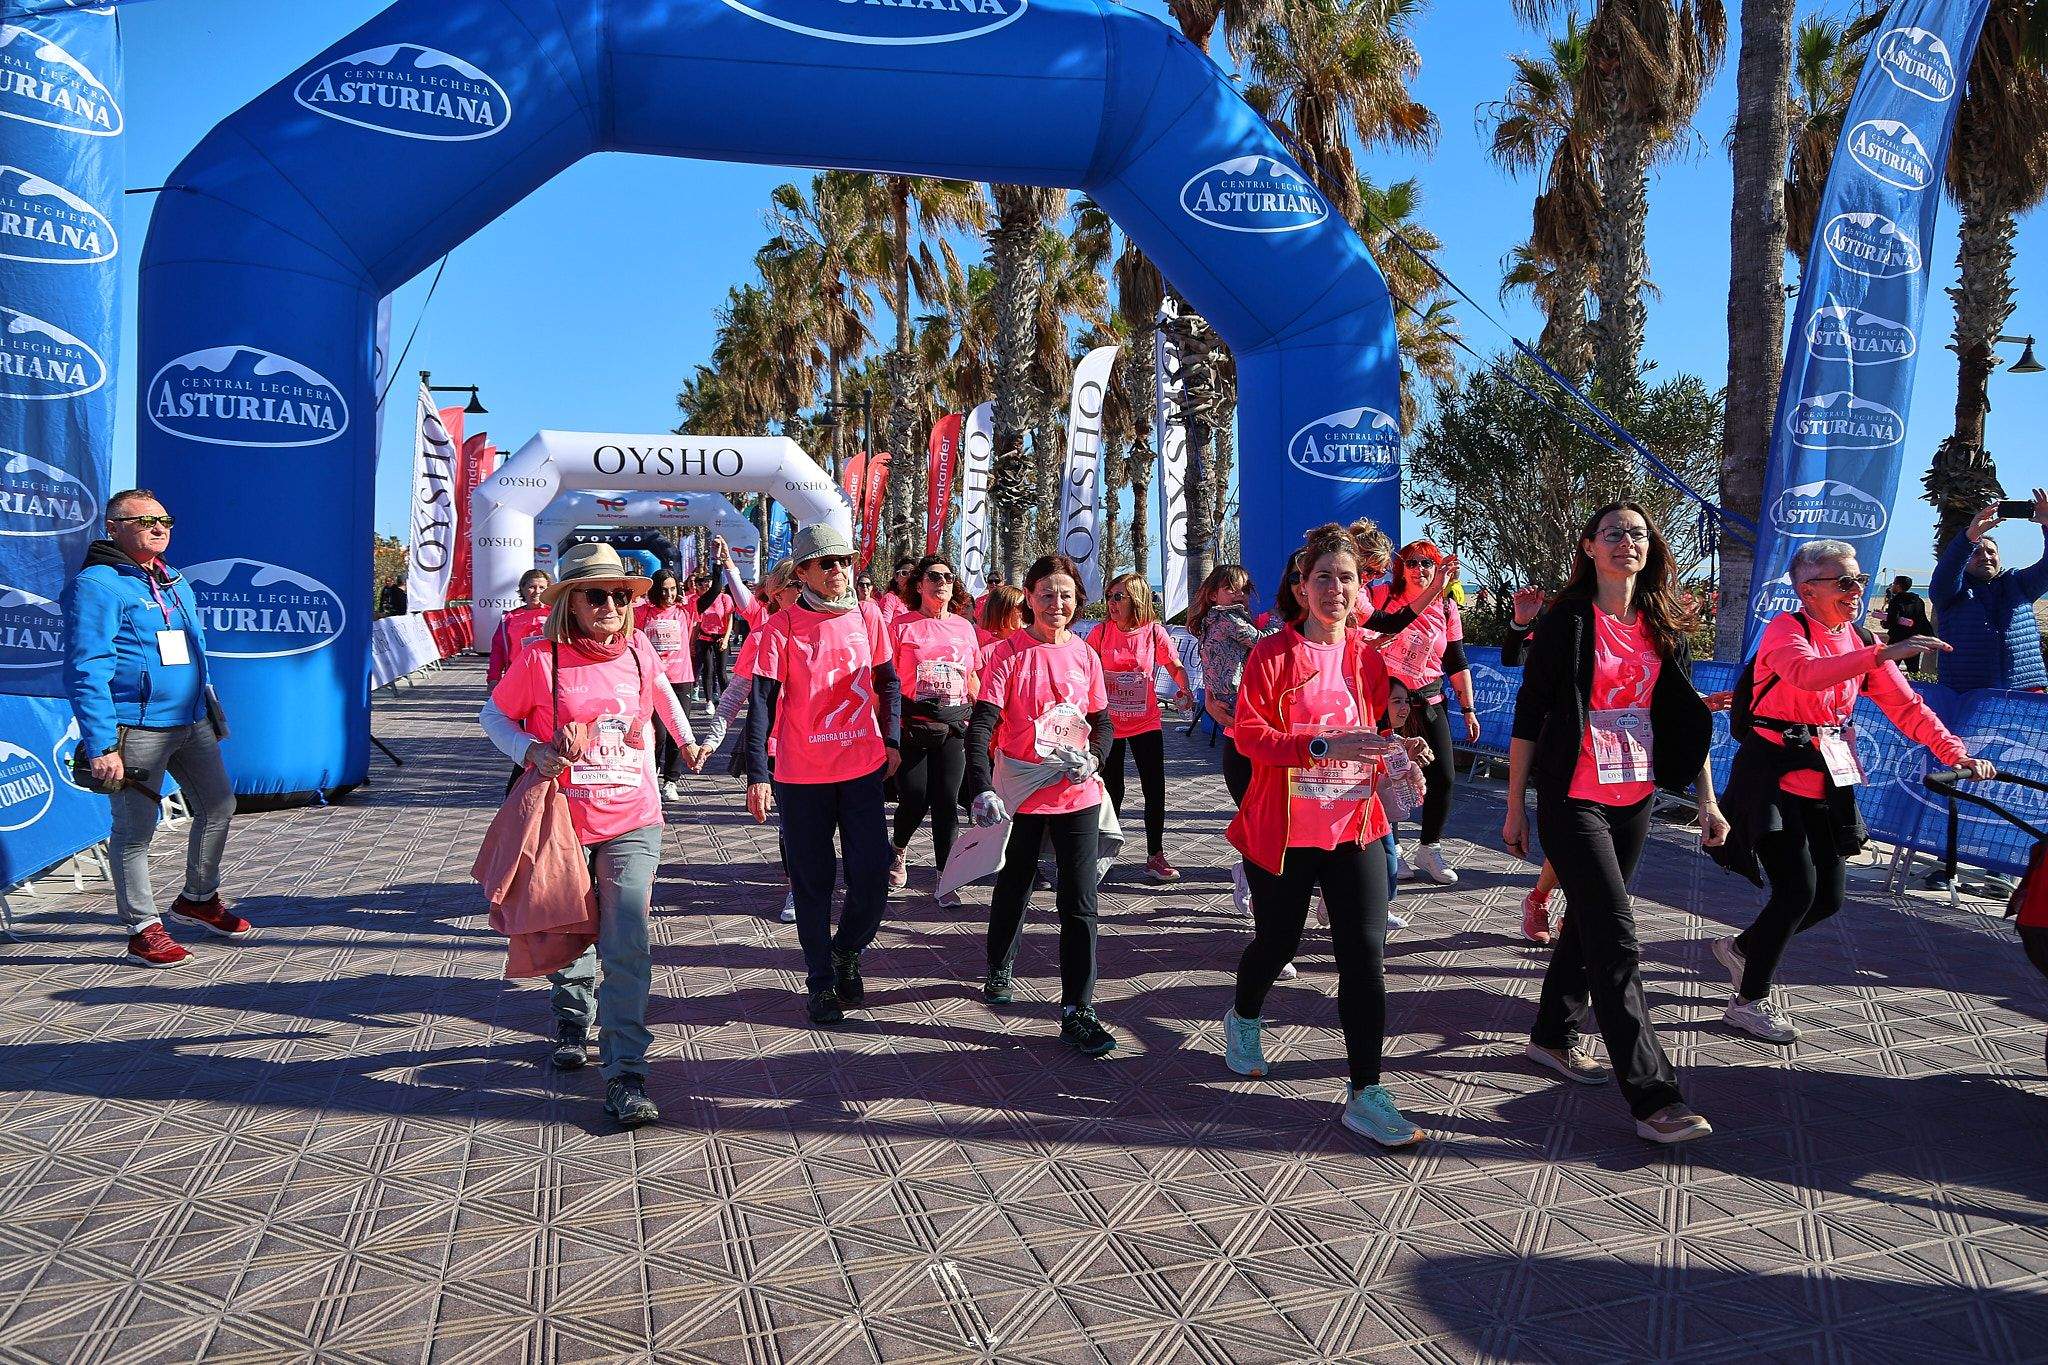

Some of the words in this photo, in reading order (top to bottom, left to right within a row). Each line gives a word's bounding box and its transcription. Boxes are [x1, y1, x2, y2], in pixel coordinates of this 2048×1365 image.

[40, 66, 106, 103] LECHERA
[344, 70, 413, 83] CENTRAL
[421, 75, 490, 96] LECHERA
[0, 69, 112, 130] URIANA
[1222, 180, 1271, 190] CENTRAL
[23, 202, 97, 228] LECHERA
[0, 211, 102, 255] RIANA
[13, 340, 82, 359] LECHERA
[0, 352, 88, 387] RIANA
[181, 378, 253, 391] CENTRAL
[261, 382, 331, 402] LECHERA
[1324, 432, 1372, 441] CENTRAL
[593, 445, 744, 477] OYSHO
[499, 476, 547, 488] OYSHO
[935, 436, 951, 517] Santander
[1065, 380, 1102, 564] OYSHO
[12, 479, 80, 496] LECHERA
[416, 413, 451, 573] OYSHO
[785, 481, 828, 491] OYSHO
[0, 490, 85, 522] RIANA
[478, 537, 523, 549] OYSHO
[575, 535, 642, 543] VOLVO
[201, 592, 250, 602] NTRAL
[258, 593, 328, 605] LECHERA
[5, 613, 64, 627] LECHER
[197, 605, 334, 634] TURIANA
[1401, 647, 1417, 659] 016
[934, 681, 952, 689] 016
[808, 732, 838, 744] CARRERA
[839, 731, 848, 740] DE
[849, 730, 857, 739] LA
[1622, 741, 1643, 753] 016
[0, 772, 50, 808] URIANA
